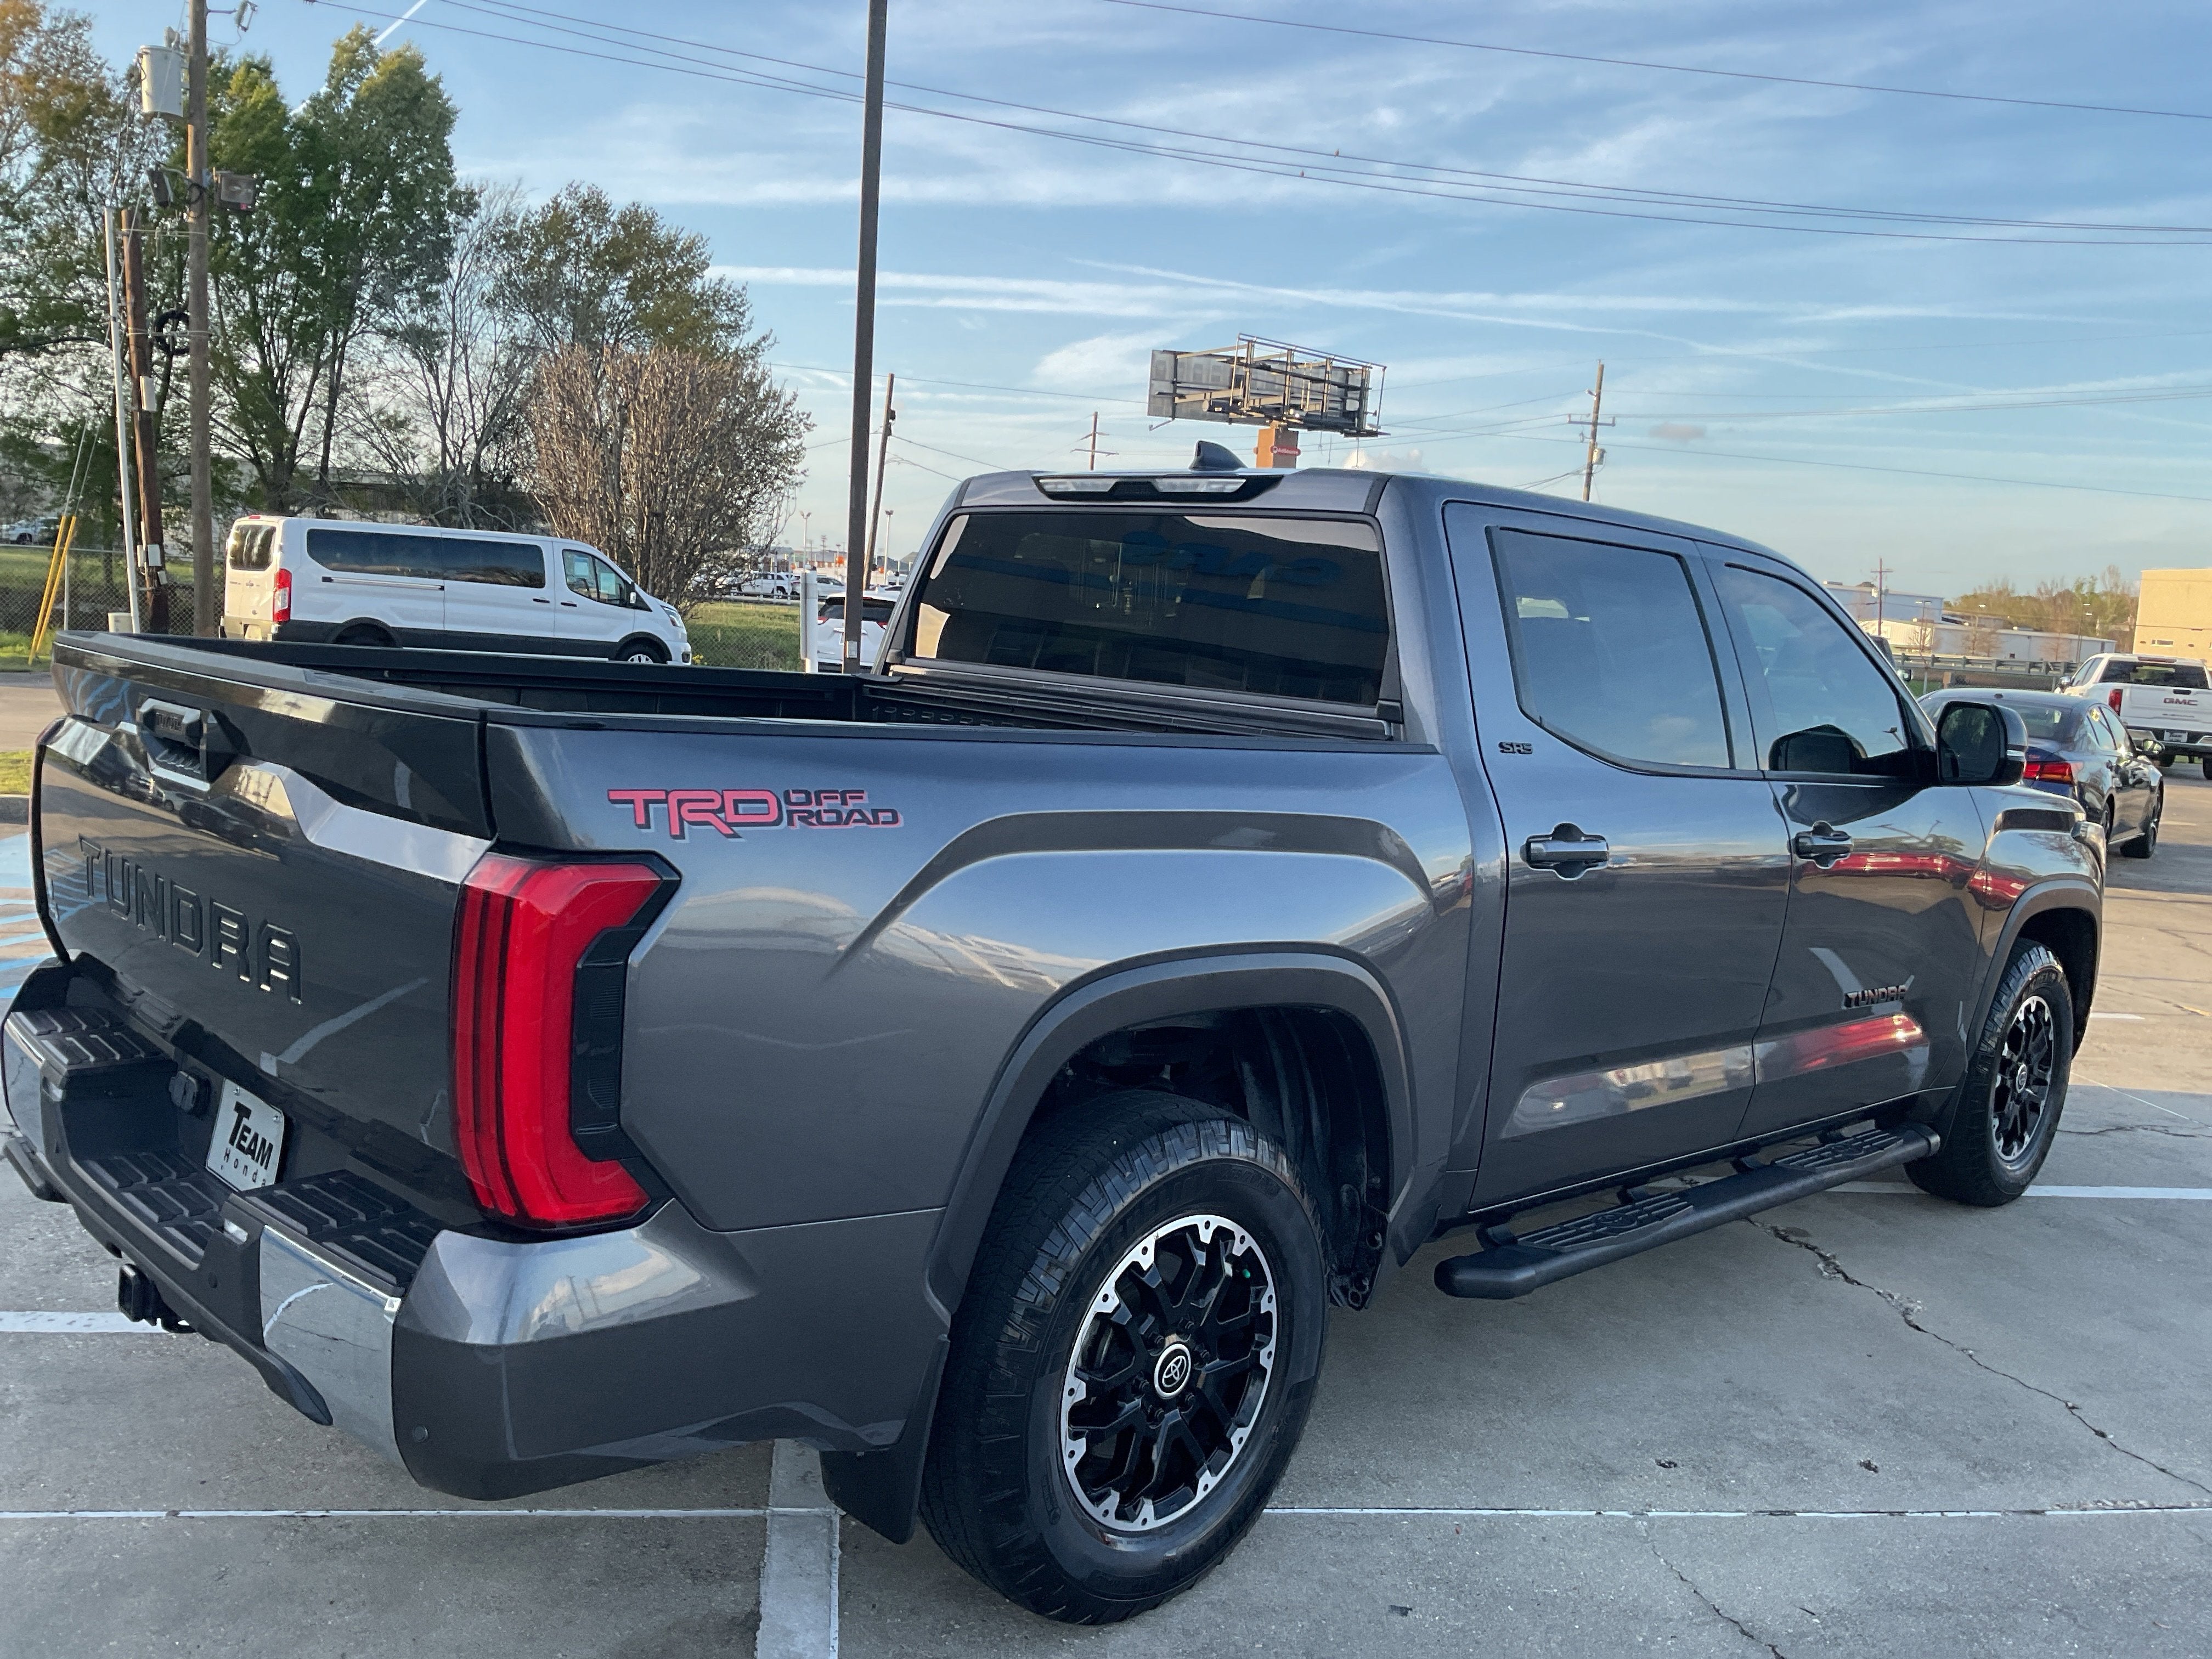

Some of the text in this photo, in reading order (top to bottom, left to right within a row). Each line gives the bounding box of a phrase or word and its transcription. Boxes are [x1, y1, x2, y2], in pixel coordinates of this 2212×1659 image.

[2163, 697, 2198, 706] GMC
[1498, 741, 1532, 754] SR5
[783, 789, 868, 808] OFF
[607, 788, 785, 842] TRD
[786, 808, 902, 830] ROAD
[78, 833, 302, 1006] TUNDRA
[1844, 984, 1908, 1008] TUNDRA
[228, 1101, 274, 1171] TEAM
[223, 1147, 267, 1187] Honda
